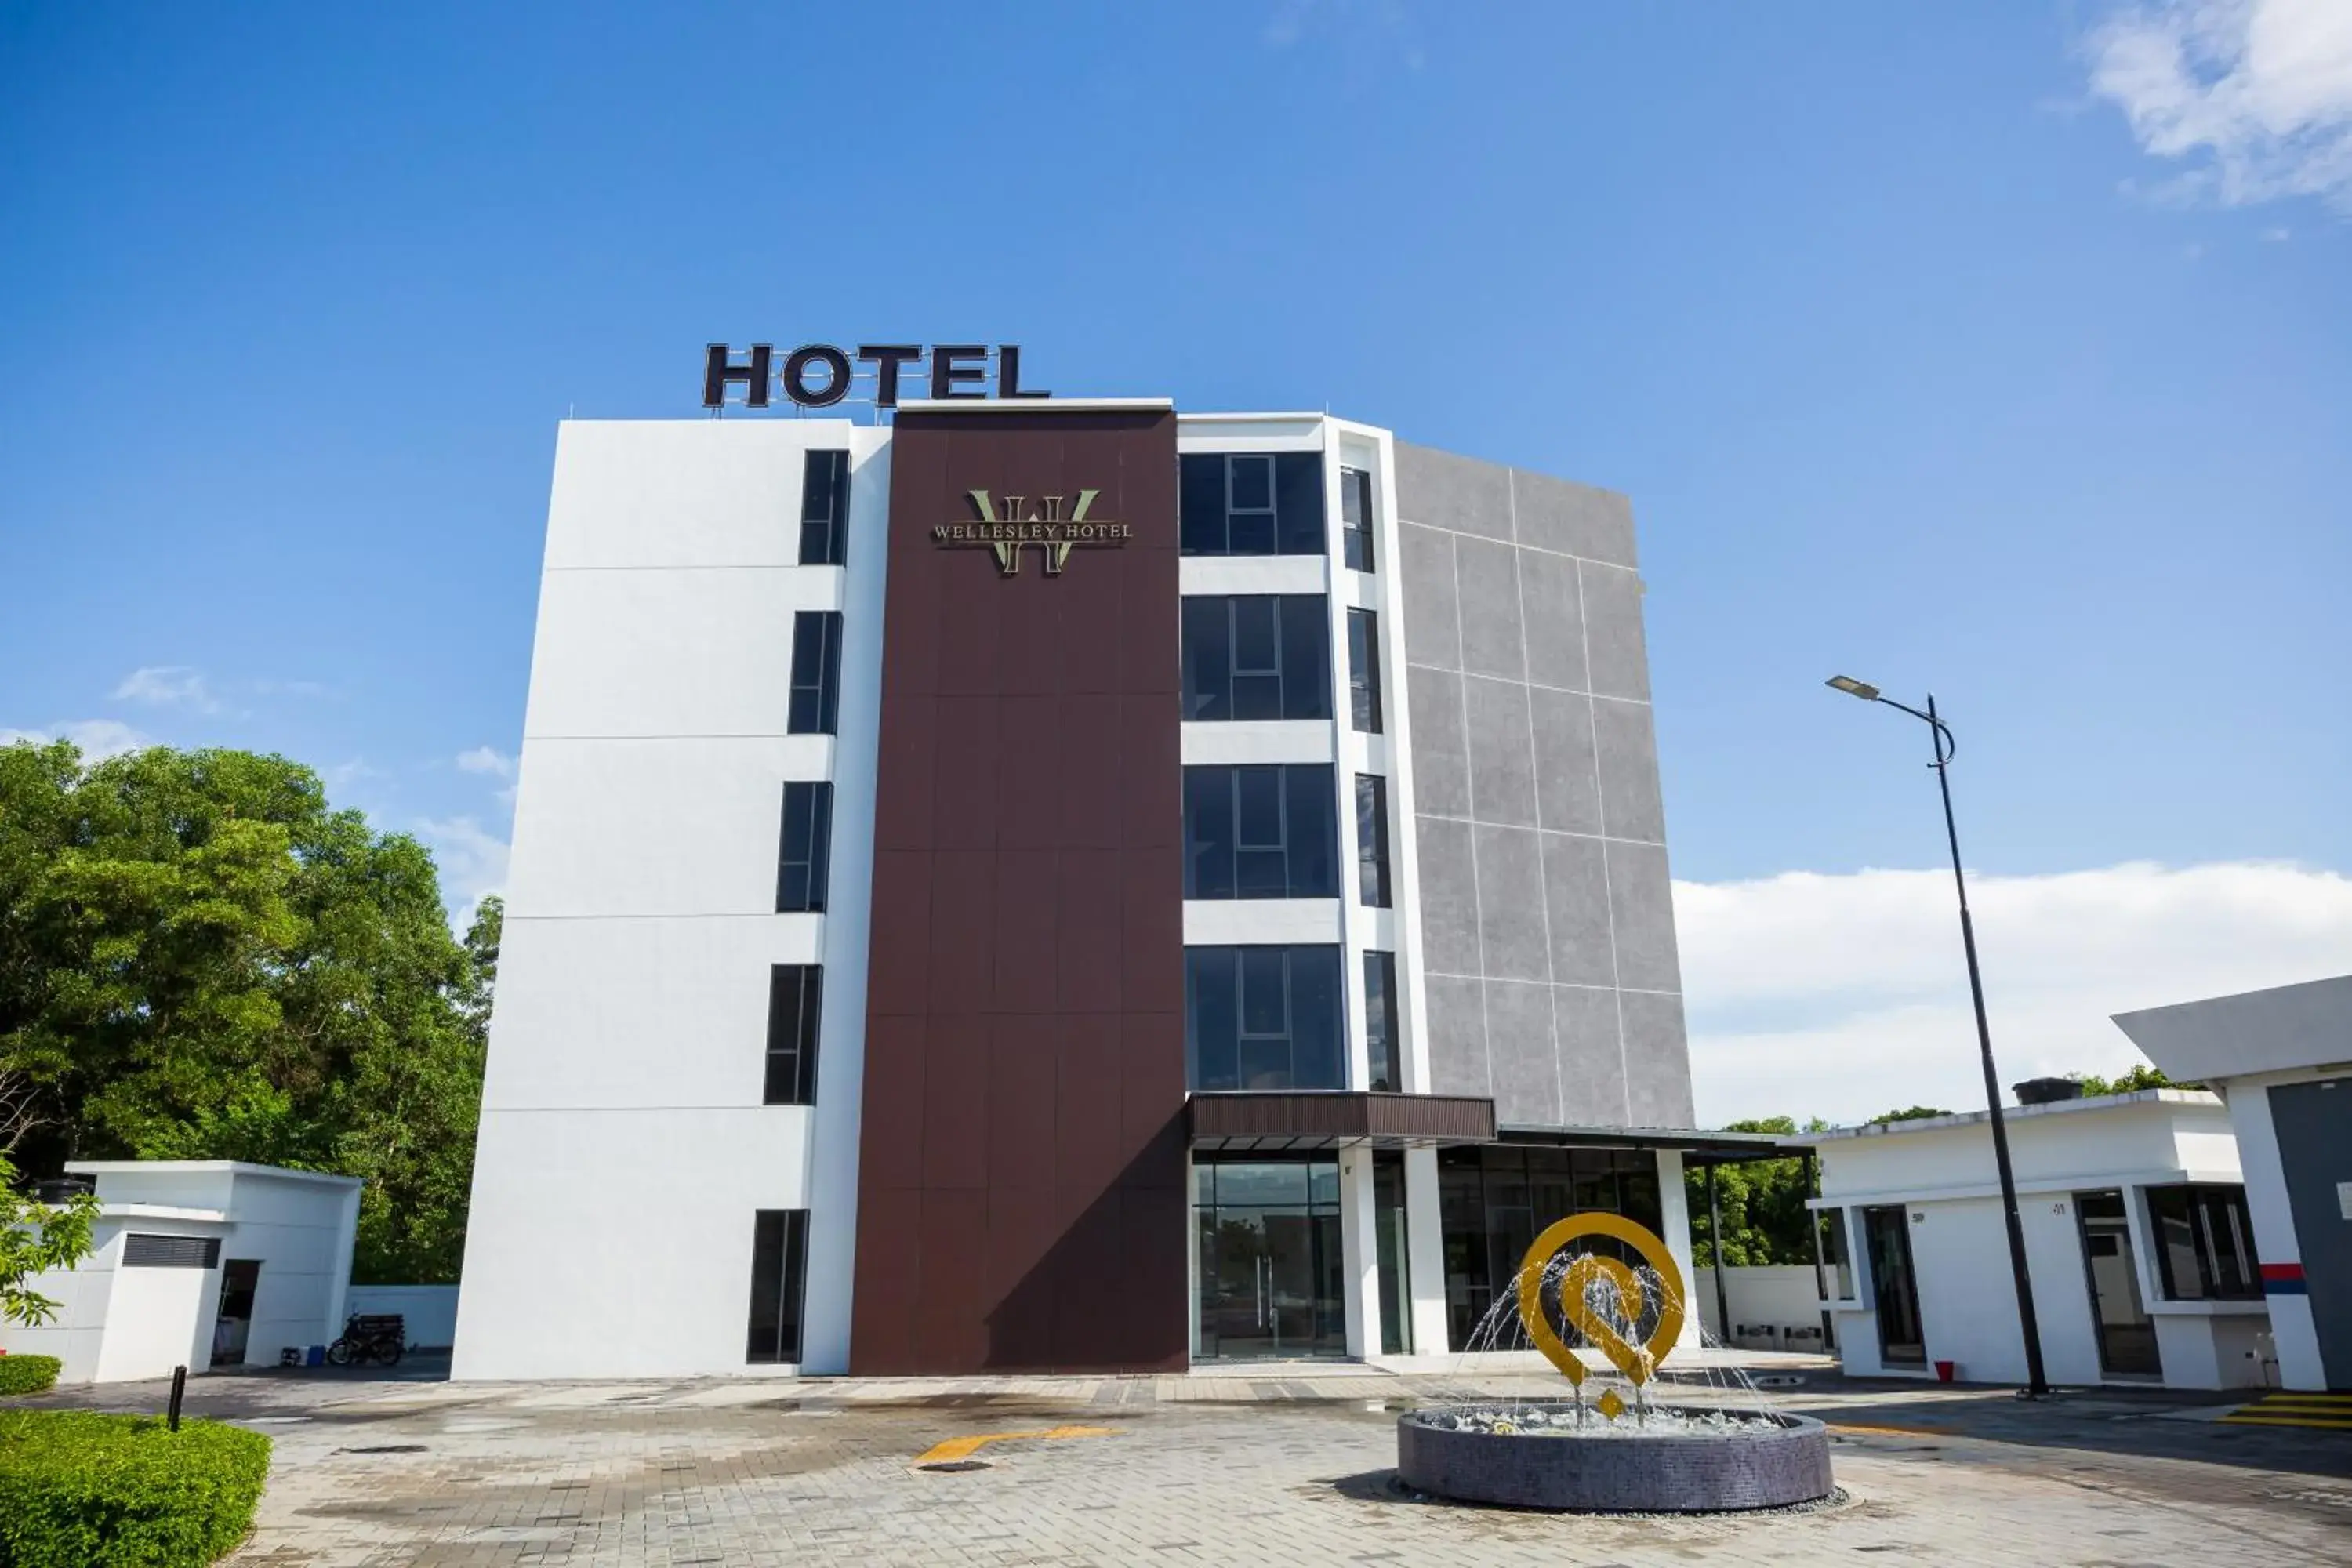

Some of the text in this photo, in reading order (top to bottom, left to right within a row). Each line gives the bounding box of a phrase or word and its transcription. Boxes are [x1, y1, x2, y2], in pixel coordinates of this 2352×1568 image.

[702, 343, 1051, 408] HOTEL
[935, 524, 1133, 539] WELLESLEY HOTEL
